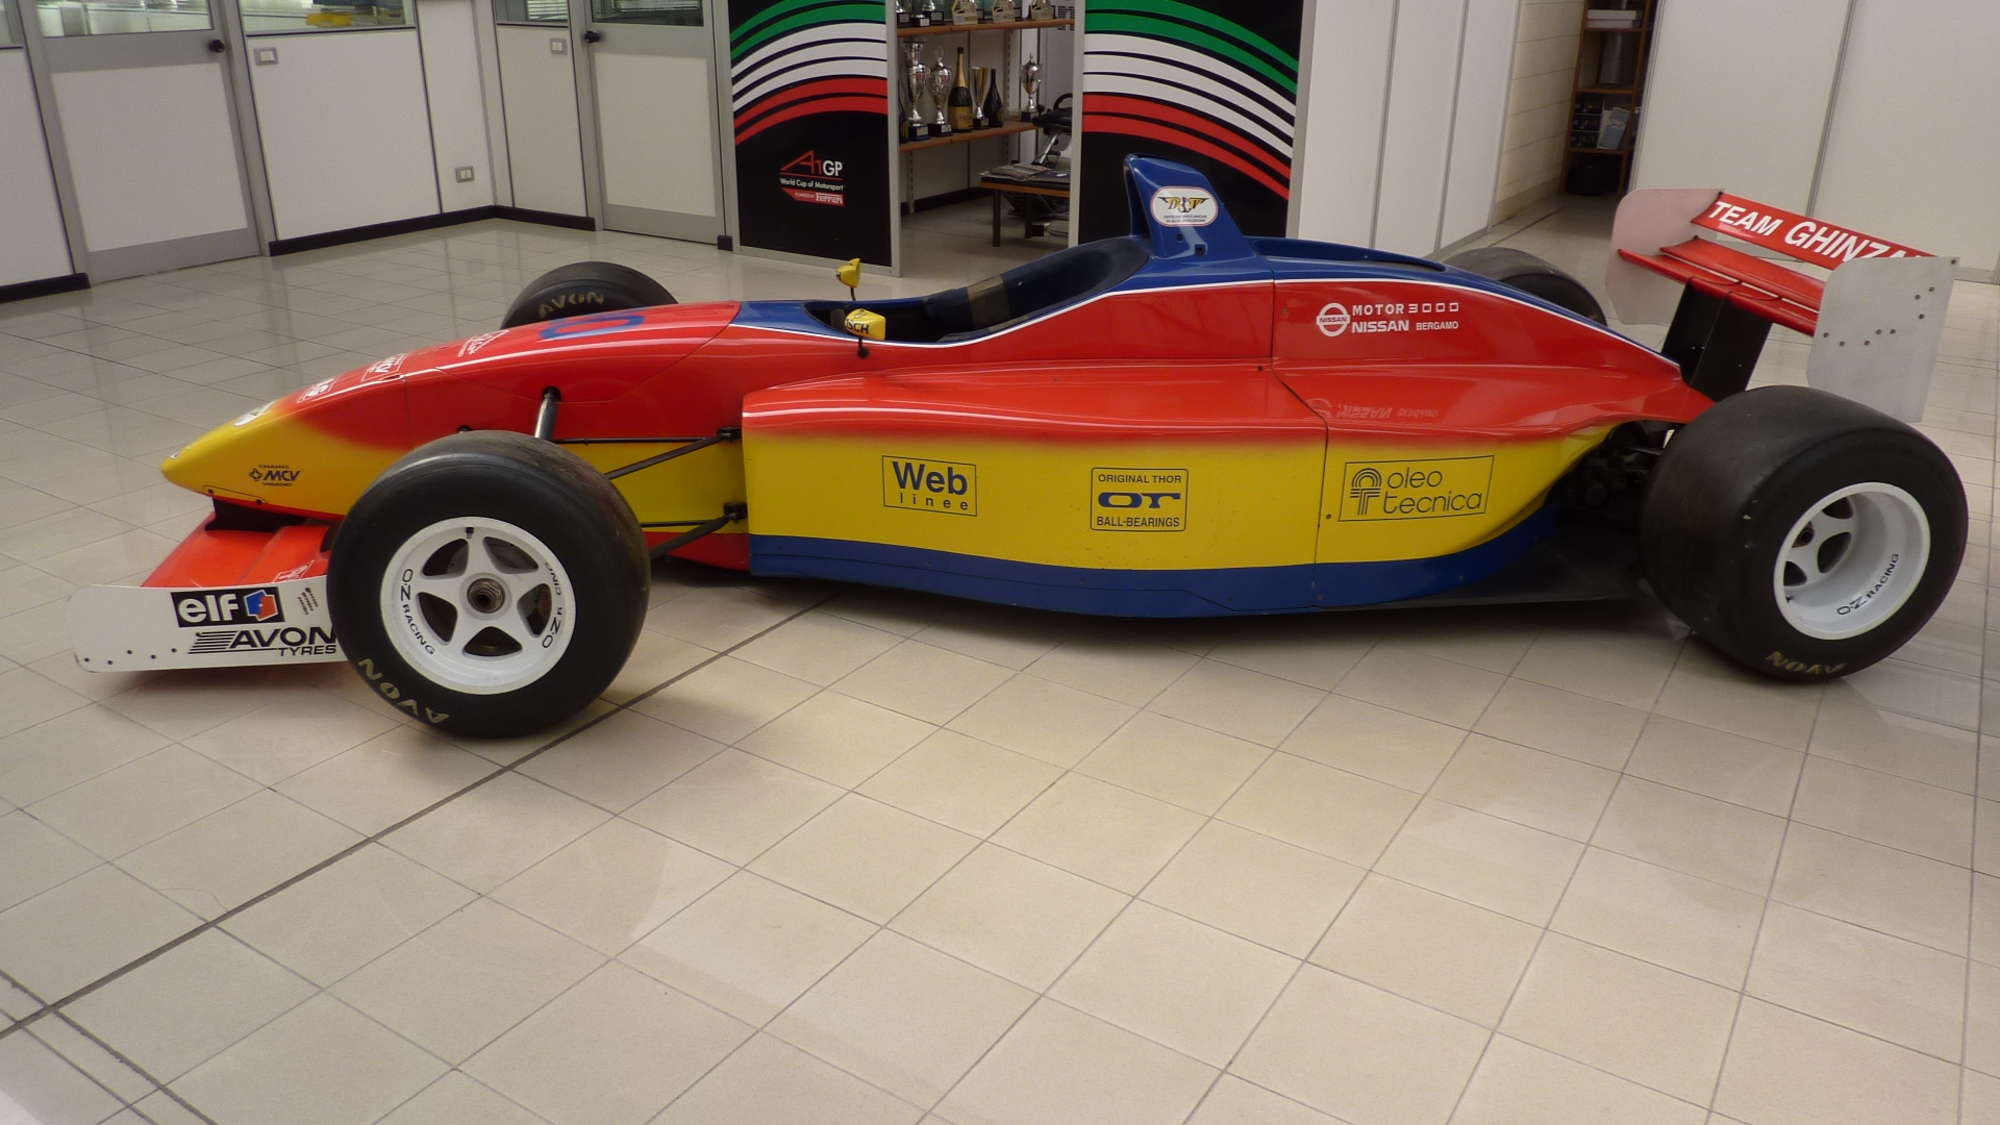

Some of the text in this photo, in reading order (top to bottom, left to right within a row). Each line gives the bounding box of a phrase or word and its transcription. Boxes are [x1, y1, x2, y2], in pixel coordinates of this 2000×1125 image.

[1708, 201, 1784, 236] TEAM
[1352, 302, 1460, 316] MOTOR 3000
[1352, 320, 1460, 333] NISSAN BERGAMO
[263, 470, 301, 481] MCV
[892, 461, 968, 495] Web
[1098, 474, 1182, 484] ORIGINAL THOR
[1387, 467, 1443, 489] oleo
[1383, 490, 1483, 514] tecnica
[1096, 516, 1180, 528] BALL-BEARINGS
[1866, 553, 1899, 598] RACING
[178, 593, 239, 623] elf
[229, 626, 337, 649] AVON
[402, 604, 435, 656] RACING
[277, 645, 336, 657] TYRES
[357, 657, 449, 724] AVON
